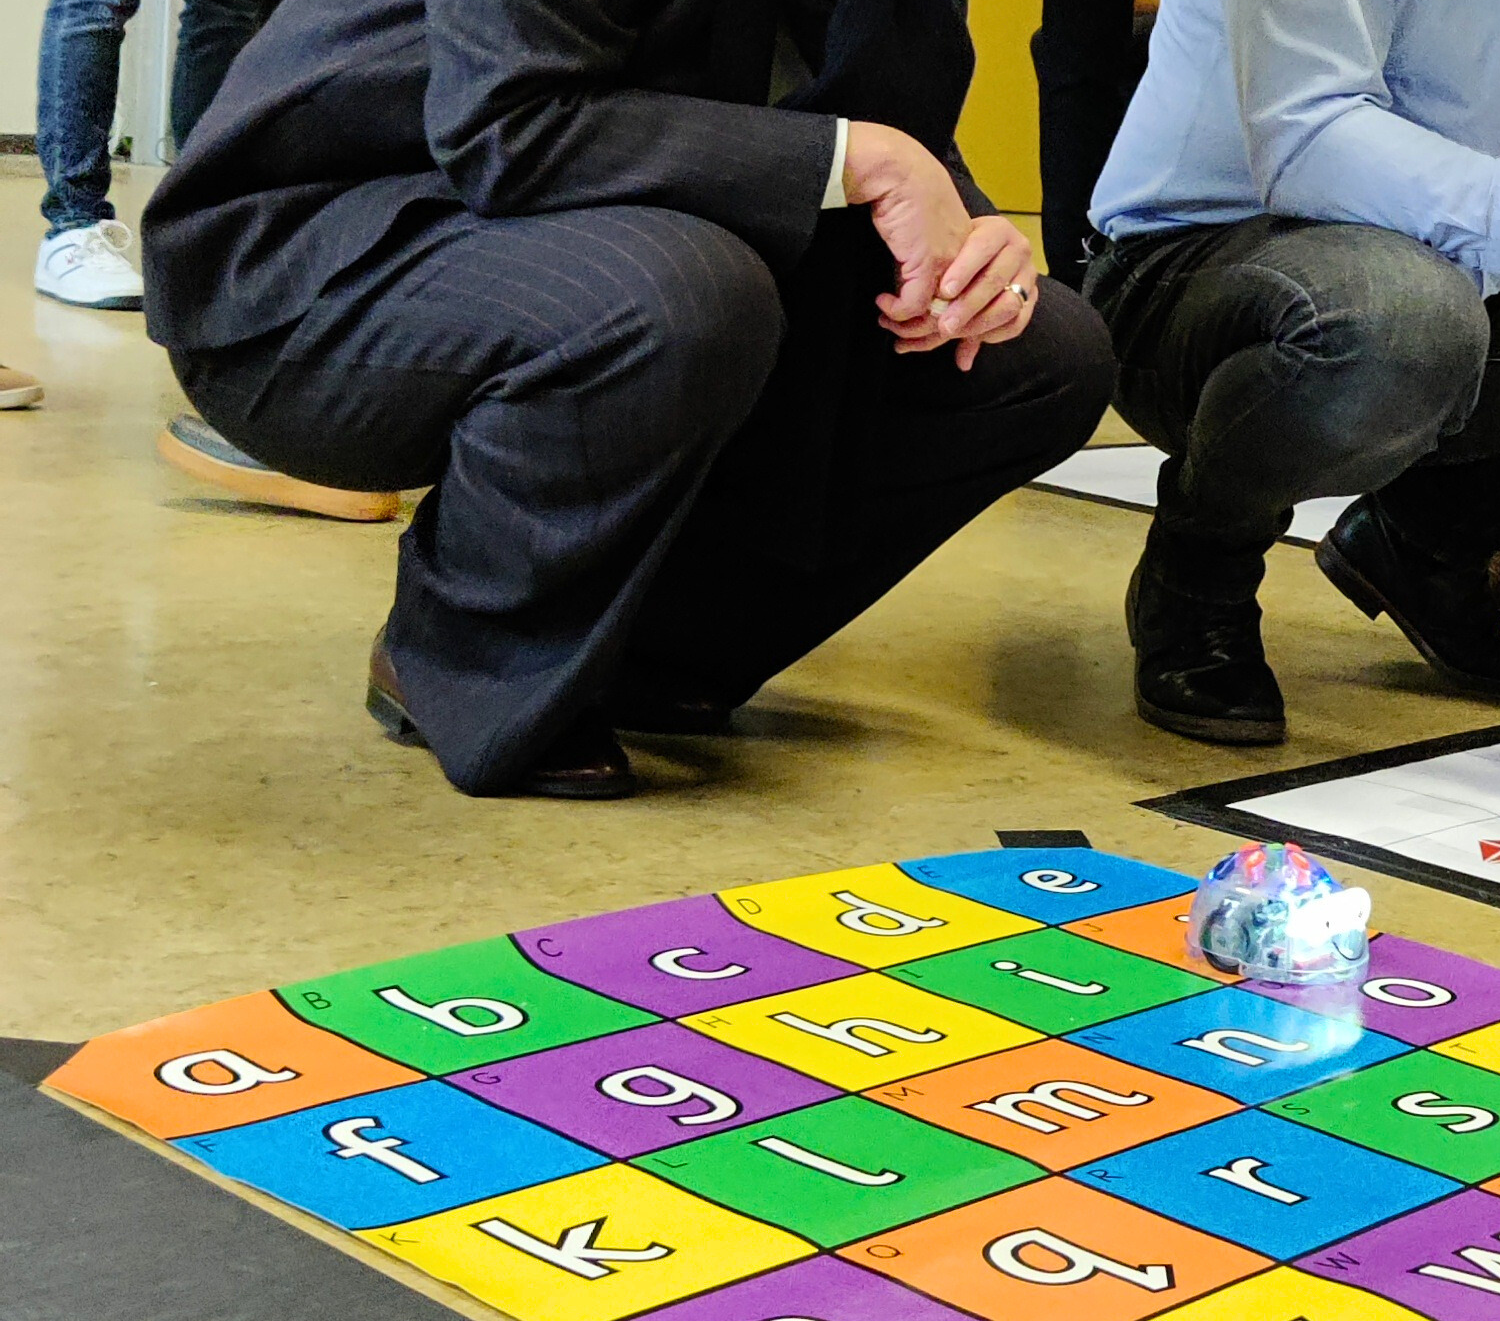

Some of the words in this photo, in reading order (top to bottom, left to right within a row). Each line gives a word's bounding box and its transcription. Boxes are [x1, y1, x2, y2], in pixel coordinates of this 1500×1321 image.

[1019, 869, 1101, 894] e
[830, 890, 949, 936] d
[647, 947, 751, 980] c
[991, 960, 1110, 995] i
[374, 986, 528, 1037] b
[1359, 976, 1457, 1009] o
[767, 1011, 948, 1058] h
[1175, 1029, 1310, 1067] n
[154, 1049, 301, 1096] a
[596, 1064, 743, 1126] g
[964, 1078, 1154, 1134] m
[1391, 1090, 1499, 1135] s
[321, 1116, 447, 1185] f
[1200, 1156, 1308, 1207] r
[470, 1216, 676, 1280] k
[983, 1227, 1174, 1292] q
